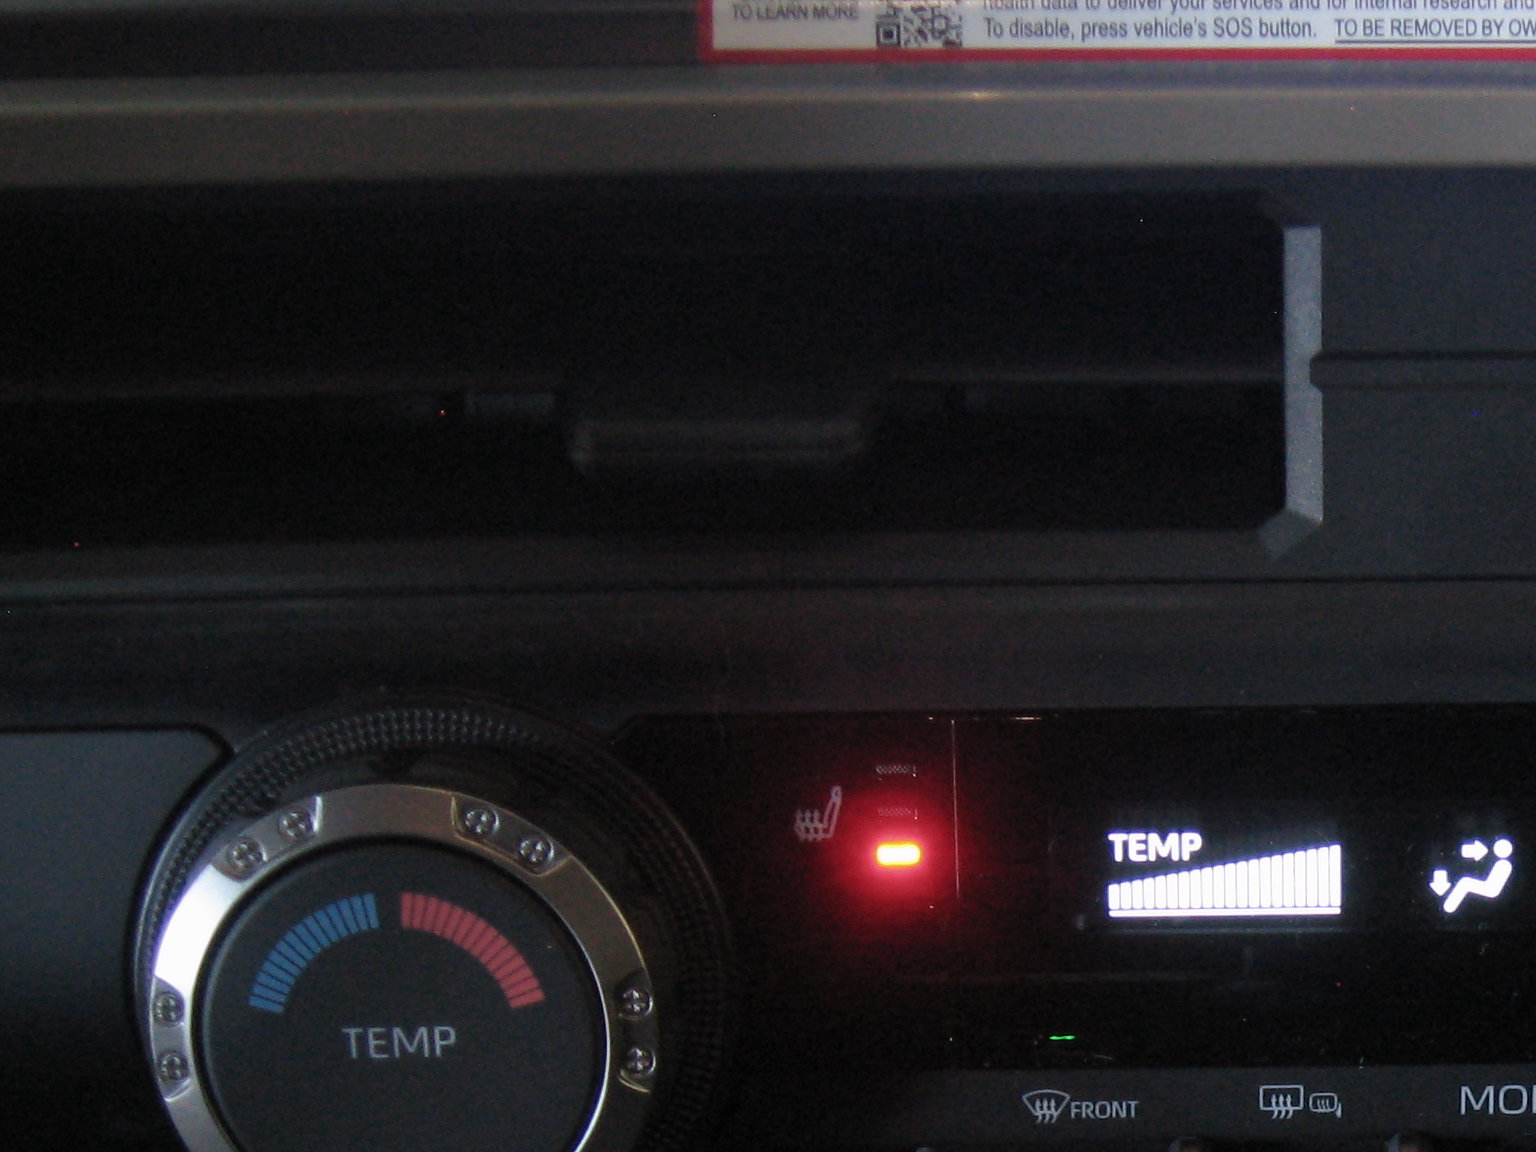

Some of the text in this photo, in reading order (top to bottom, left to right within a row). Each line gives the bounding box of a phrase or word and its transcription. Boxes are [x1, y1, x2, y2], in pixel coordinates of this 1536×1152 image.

[757, 4, 808, 20] LEARN
[983, 17, 1004, 38] To
[1009, 17, 1075, 40] disable,
[1081, 21, 1128, 42] press
[1134, 17, 1207, 38] vehicle's
[1213, 17, 1253, 38] SOS
[1259, 17, 1317, 38] button.
[1334, 18, 1358, 38] TO
[1363, 18, 1385, 37] BE
[1391, 18, 1478, 37] REMOVED
[1482, 18, 1505, 37] BY
[1107, 832, 1203, 862] TEMP
[341, 1026, 456, 1059] TEMP
[1070, 1101, 1139, 1120] FRONT
